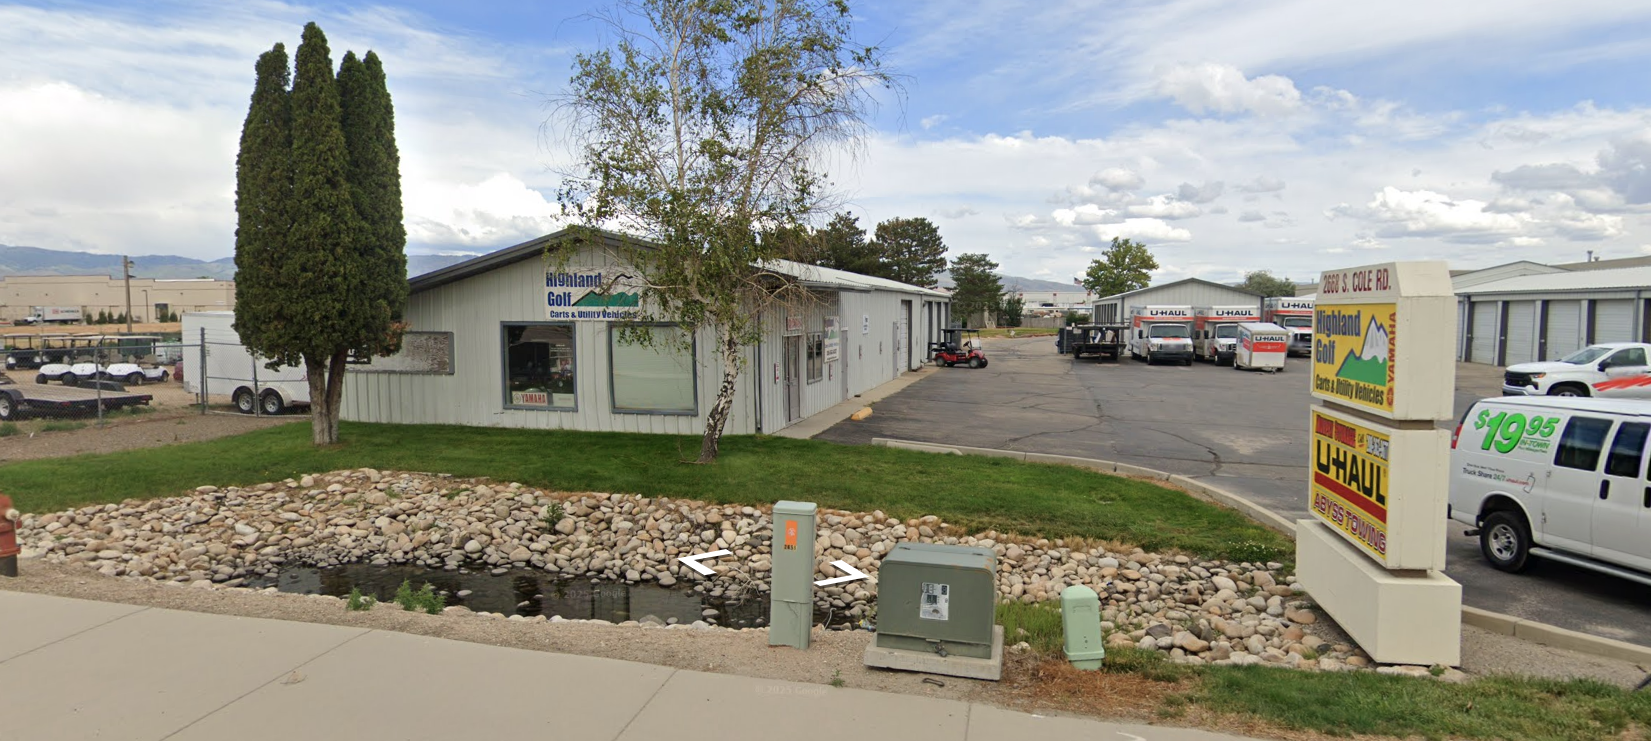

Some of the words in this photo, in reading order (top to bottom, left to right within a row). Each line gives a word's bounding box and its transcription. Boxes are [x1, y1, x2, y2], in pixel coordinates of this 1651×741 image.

[545, 272, 602, 288] Highland
[1341, 272, 1350, 293] S.
[1352, 269, 1373, 292] COLE
[1375, 267, 1392, 291] RD.
[547, 291, 572, 307] Golf
[549, 310, 570, 319] Carts
[570, 311, 577, 319] &
[577, 310, 601, 319] Utility
[601, 310, 638, 319] Vehicles
[1316, 309, 1361, 338] Highland
[1316, 338, 1336, 365] Golf
[1387, 311, 1397, 384] YAMAHA
[521, 393, 547, 404] YAMAHA
[1315, 373, 1330, 392] Carts
[1335, 377, 1355, 400] Utility
[1354, 381, 1385, 406] Vehicles
[1316, 438, 1386, 507] U-HAUL
[1463, 467, 1477, 476] Truck
[1477, 470, 1493, 480] Share
[1493, 473, 1507, 482] 24/7
[1313, 491, 1344, 526] ABYSS
[1345, 508, 1387, 555] TOWING
